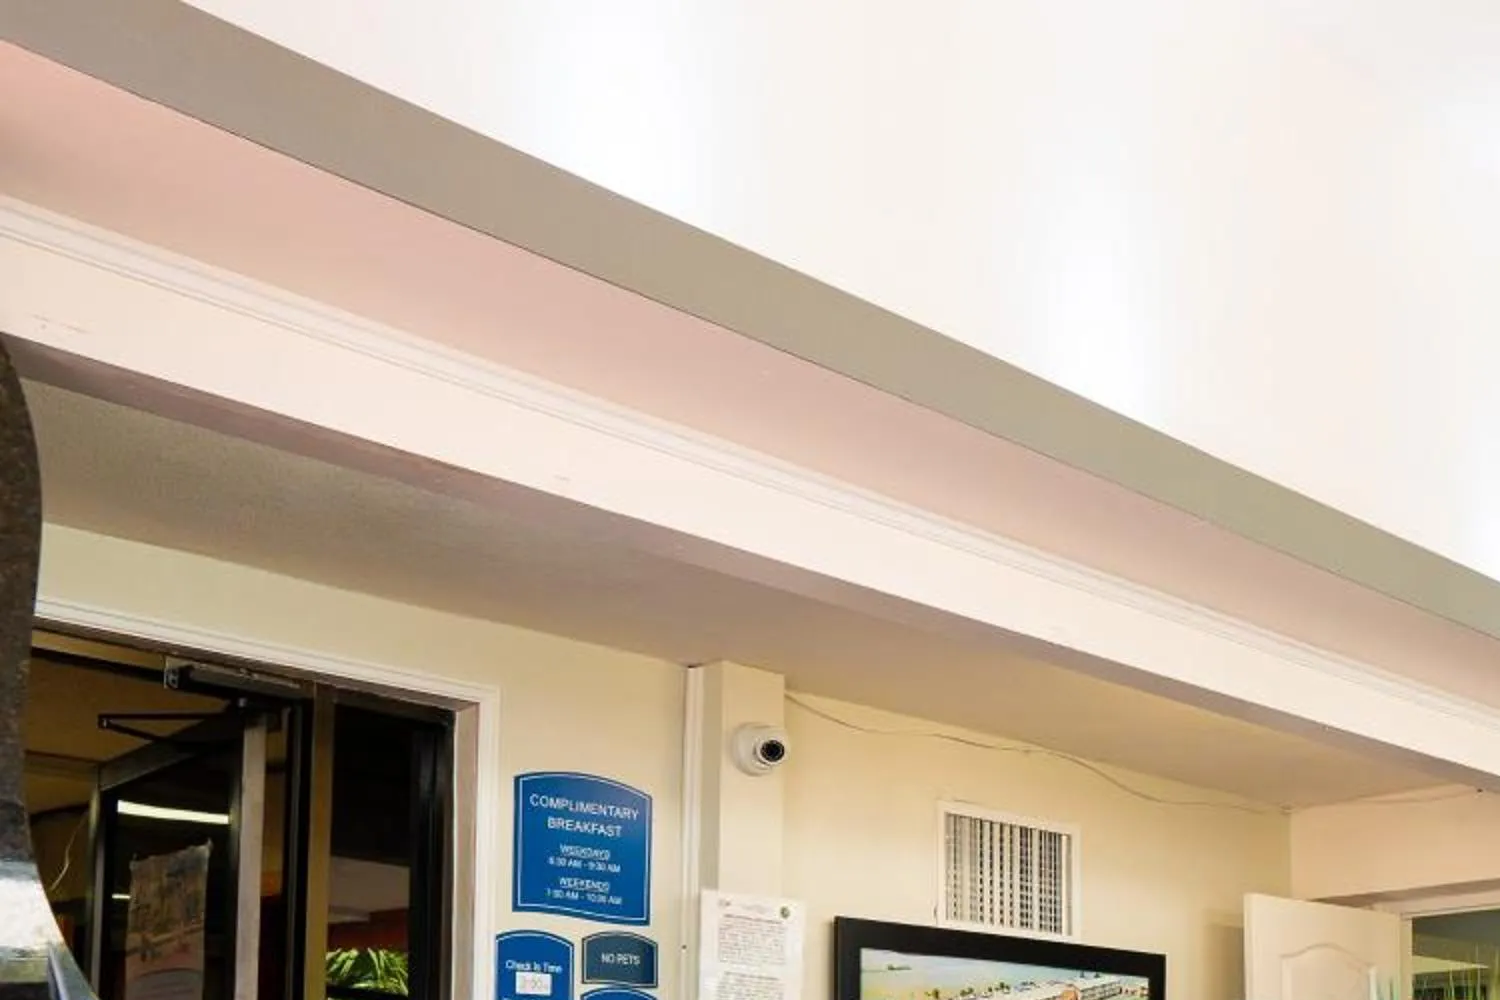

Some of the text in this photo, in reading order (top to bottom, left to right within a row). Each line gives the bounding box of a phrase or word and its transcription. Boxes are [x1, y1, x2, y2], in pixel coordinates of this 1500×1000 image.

[529, 793, 639, 820] COMPLIMENTARY
[547, 816, 622, 838] BREAKFAST
[560, 844, 611, 861] WEEKDAYS
[560, 877, 611, 894] WEEKENDS
[505, 960, 531, 971] Check
[543, 962, 563, 974] Time
[601, 952, 640, 965] NO PETS
